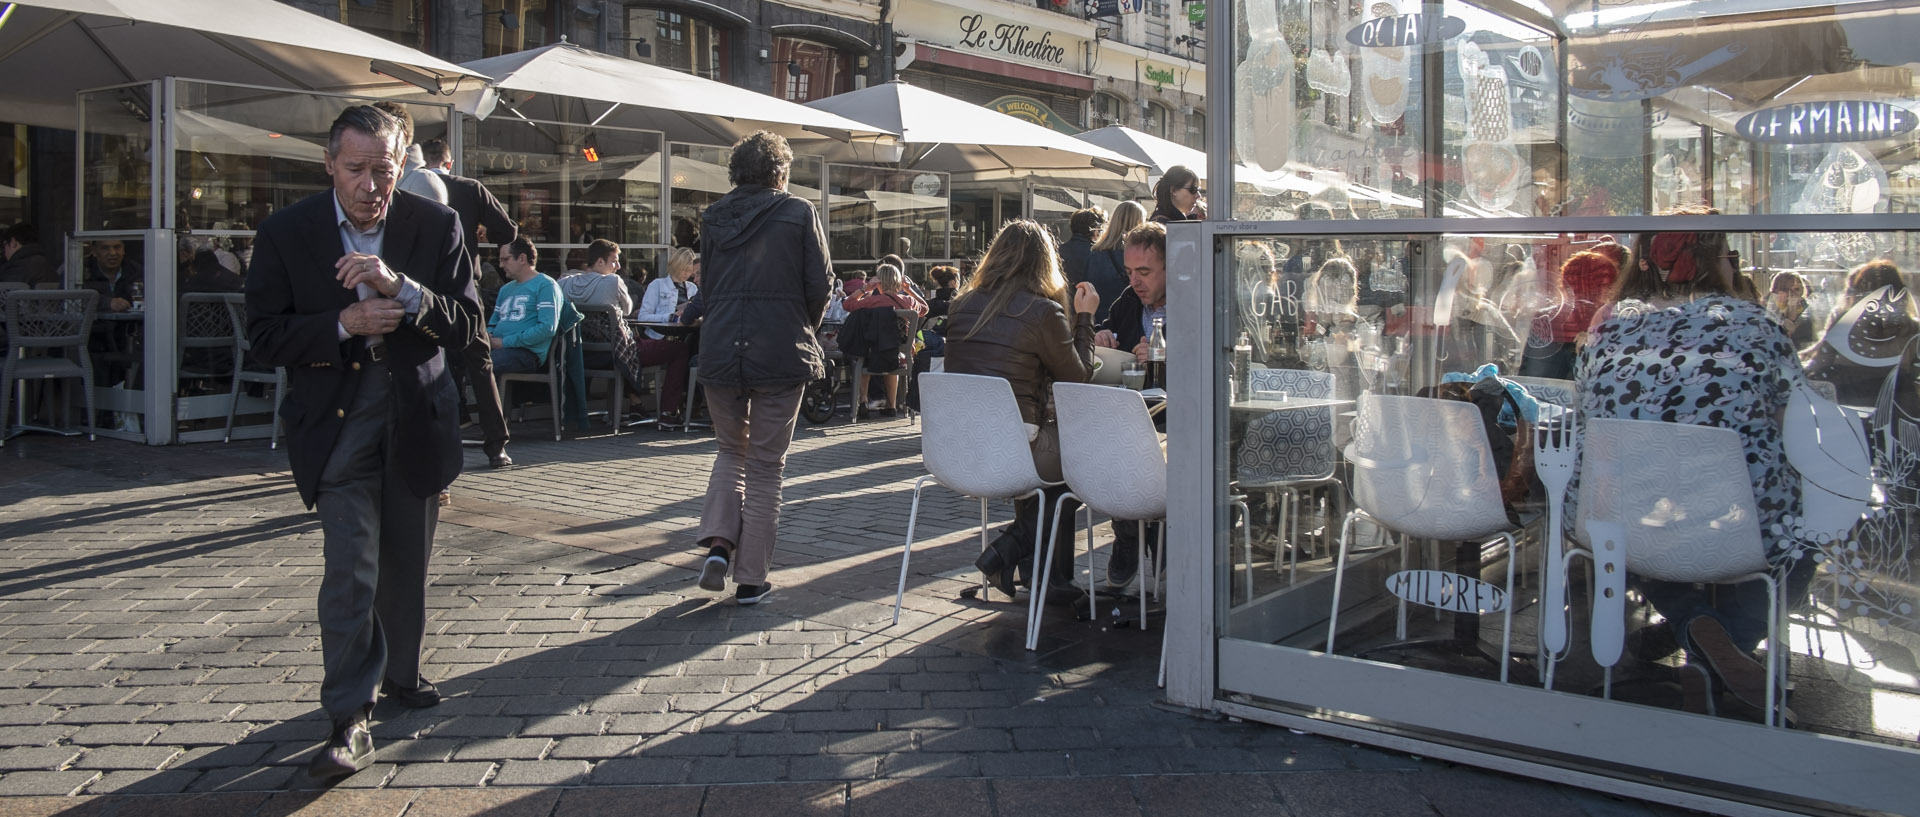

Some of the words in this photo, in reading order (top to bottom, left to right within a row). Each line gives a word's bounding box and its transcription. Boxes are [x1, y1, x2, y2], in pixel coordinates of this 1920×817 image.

[960, 14, 987, 48] Le
[989, 23, 1065, 64] Khedive
[1006, 102, 1039, 116] WELCOME
[1748, 101, 1905, 138] GERMAINE
[499, 295, 530, 321] 45
[1394, 571, 1503, 613] MILDRED
